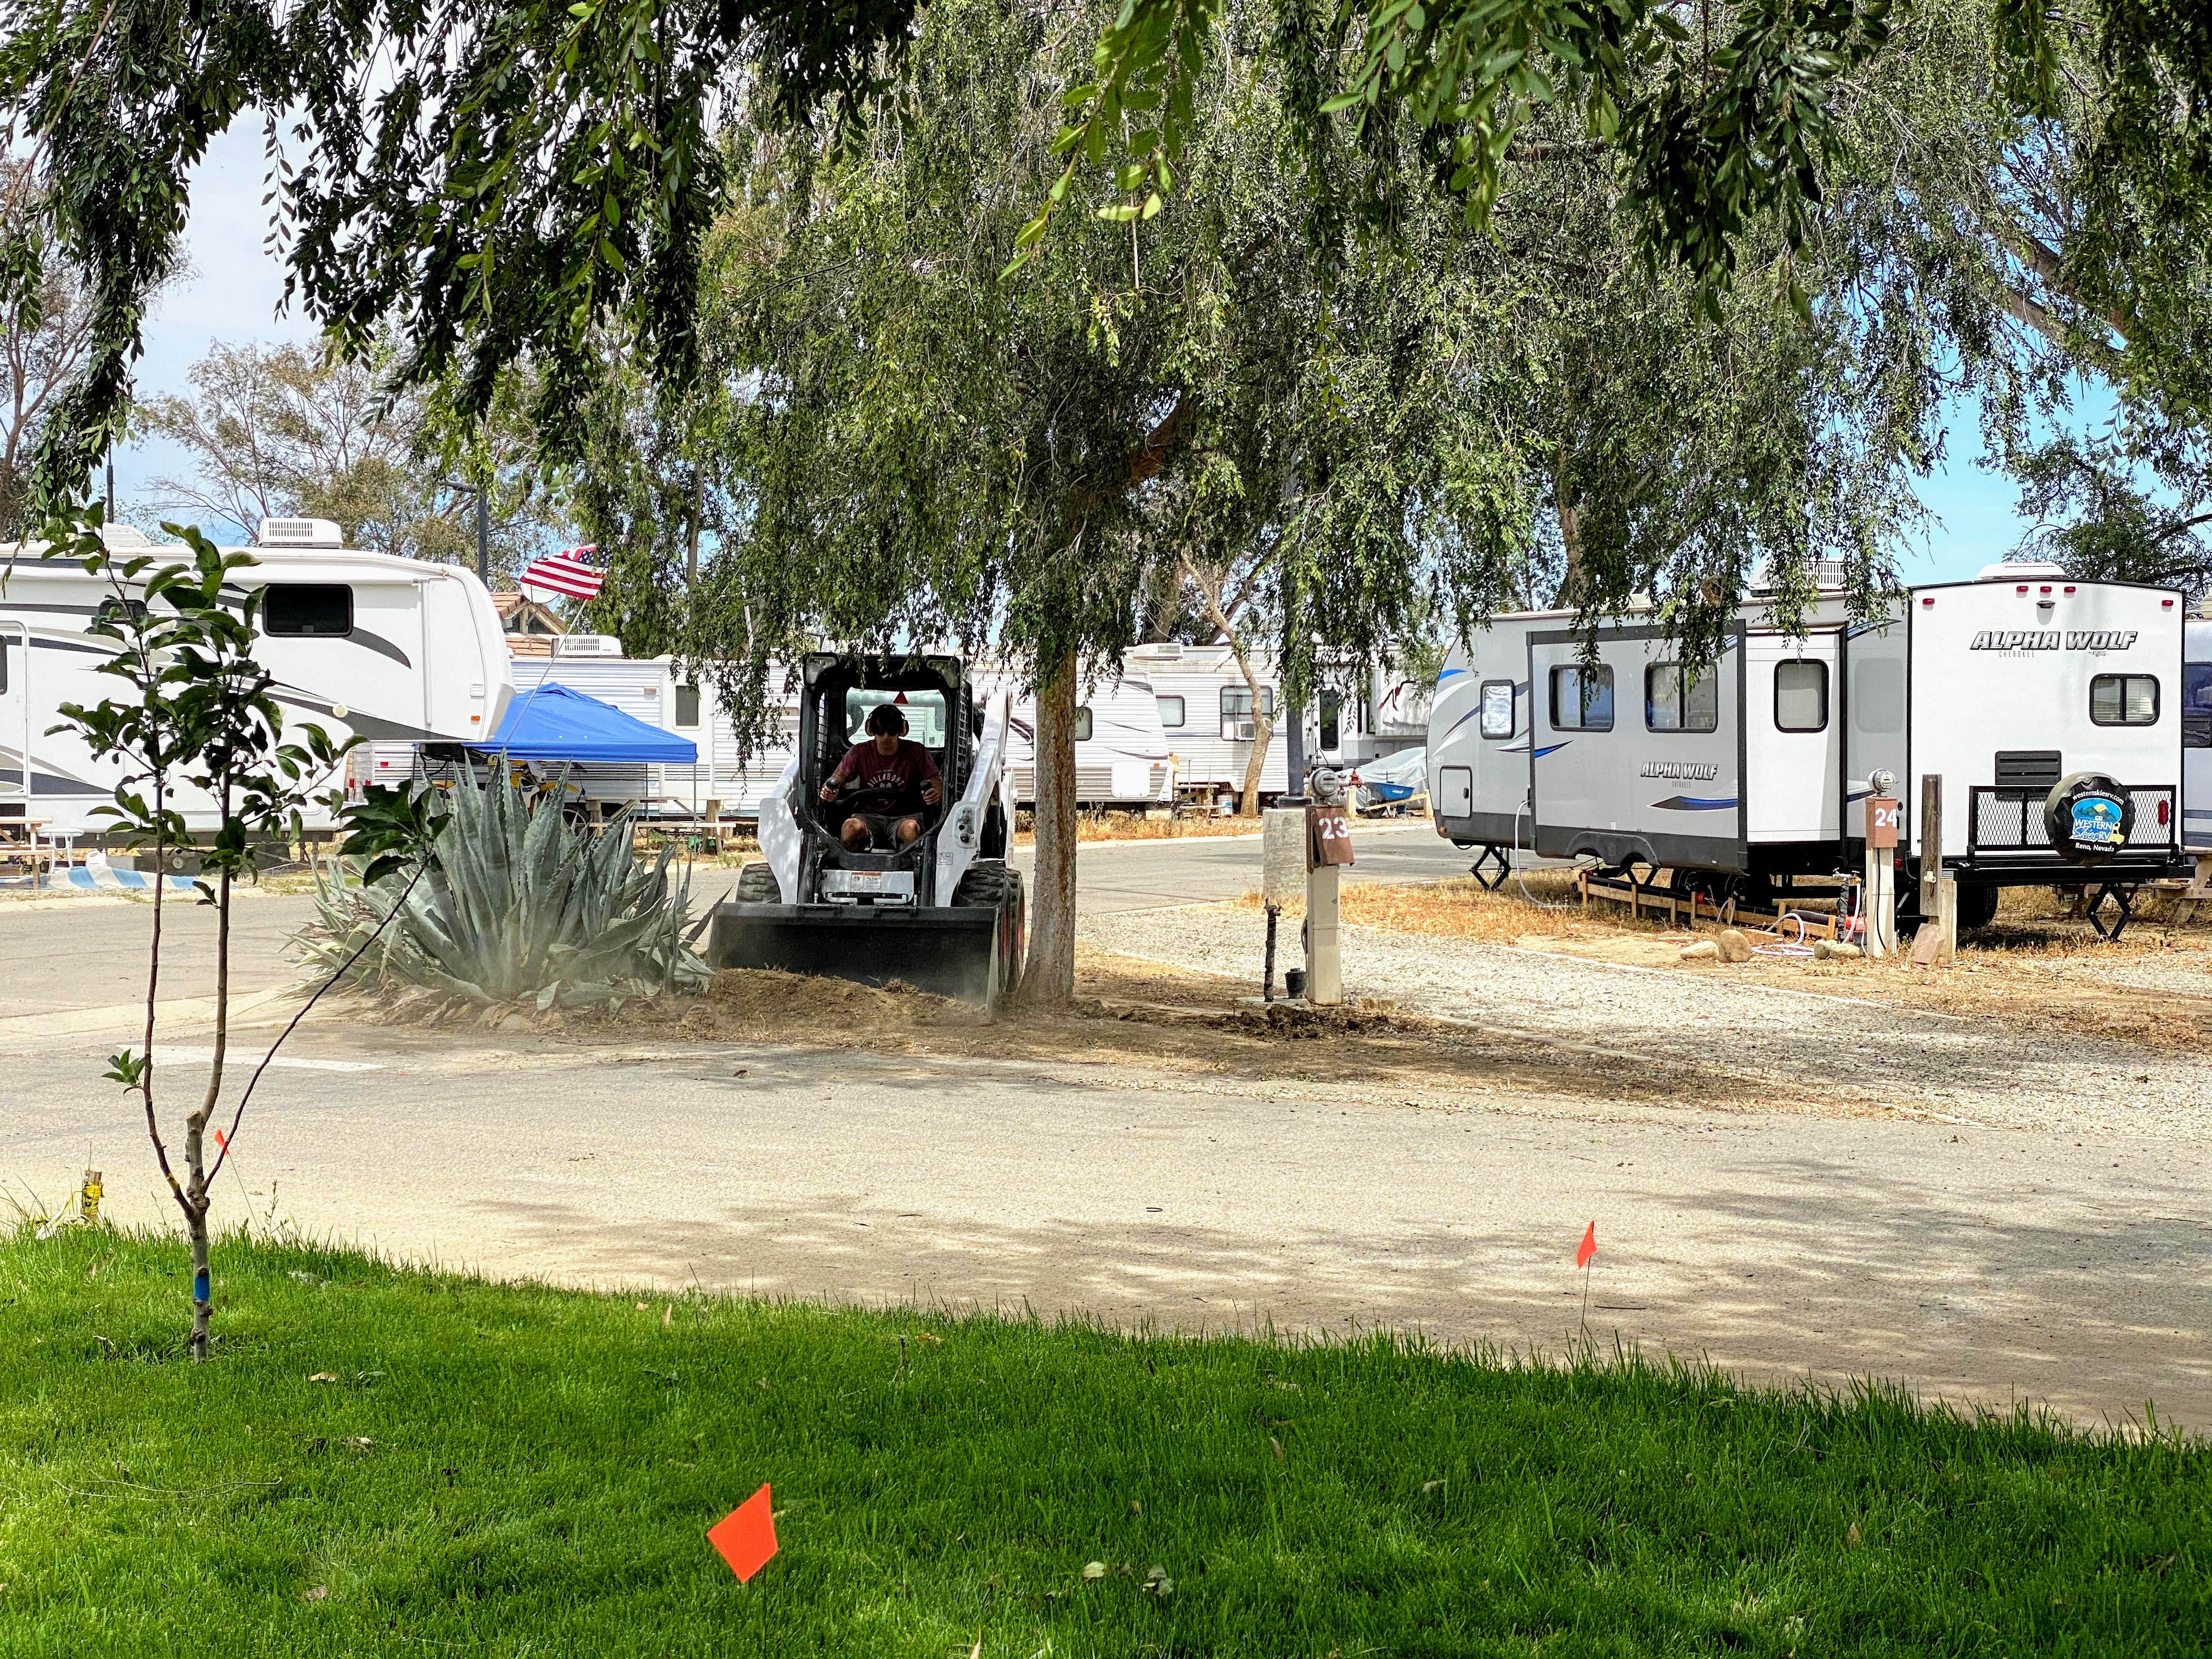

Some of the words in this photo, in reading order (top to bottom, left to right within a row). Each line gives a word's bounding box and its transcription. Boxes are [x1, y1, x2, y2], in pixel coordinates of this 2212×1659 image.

[1970, 631, 2061, 650] ALPHA
[2066, 631, 2138, 650] WOLF
[1640, 761, 1681, 778] ALPHA
[1683, 763, 1718, 780] WOLF
[2072, 789, 2124, 805] westernskiesrv.com
[1318, 816, 1349, 839] 23
[1875, 808, 1897, 828] 24
[2074, 818, 2113, 830] WESTERN
[2075, 842, 2091, 851] Reno,
